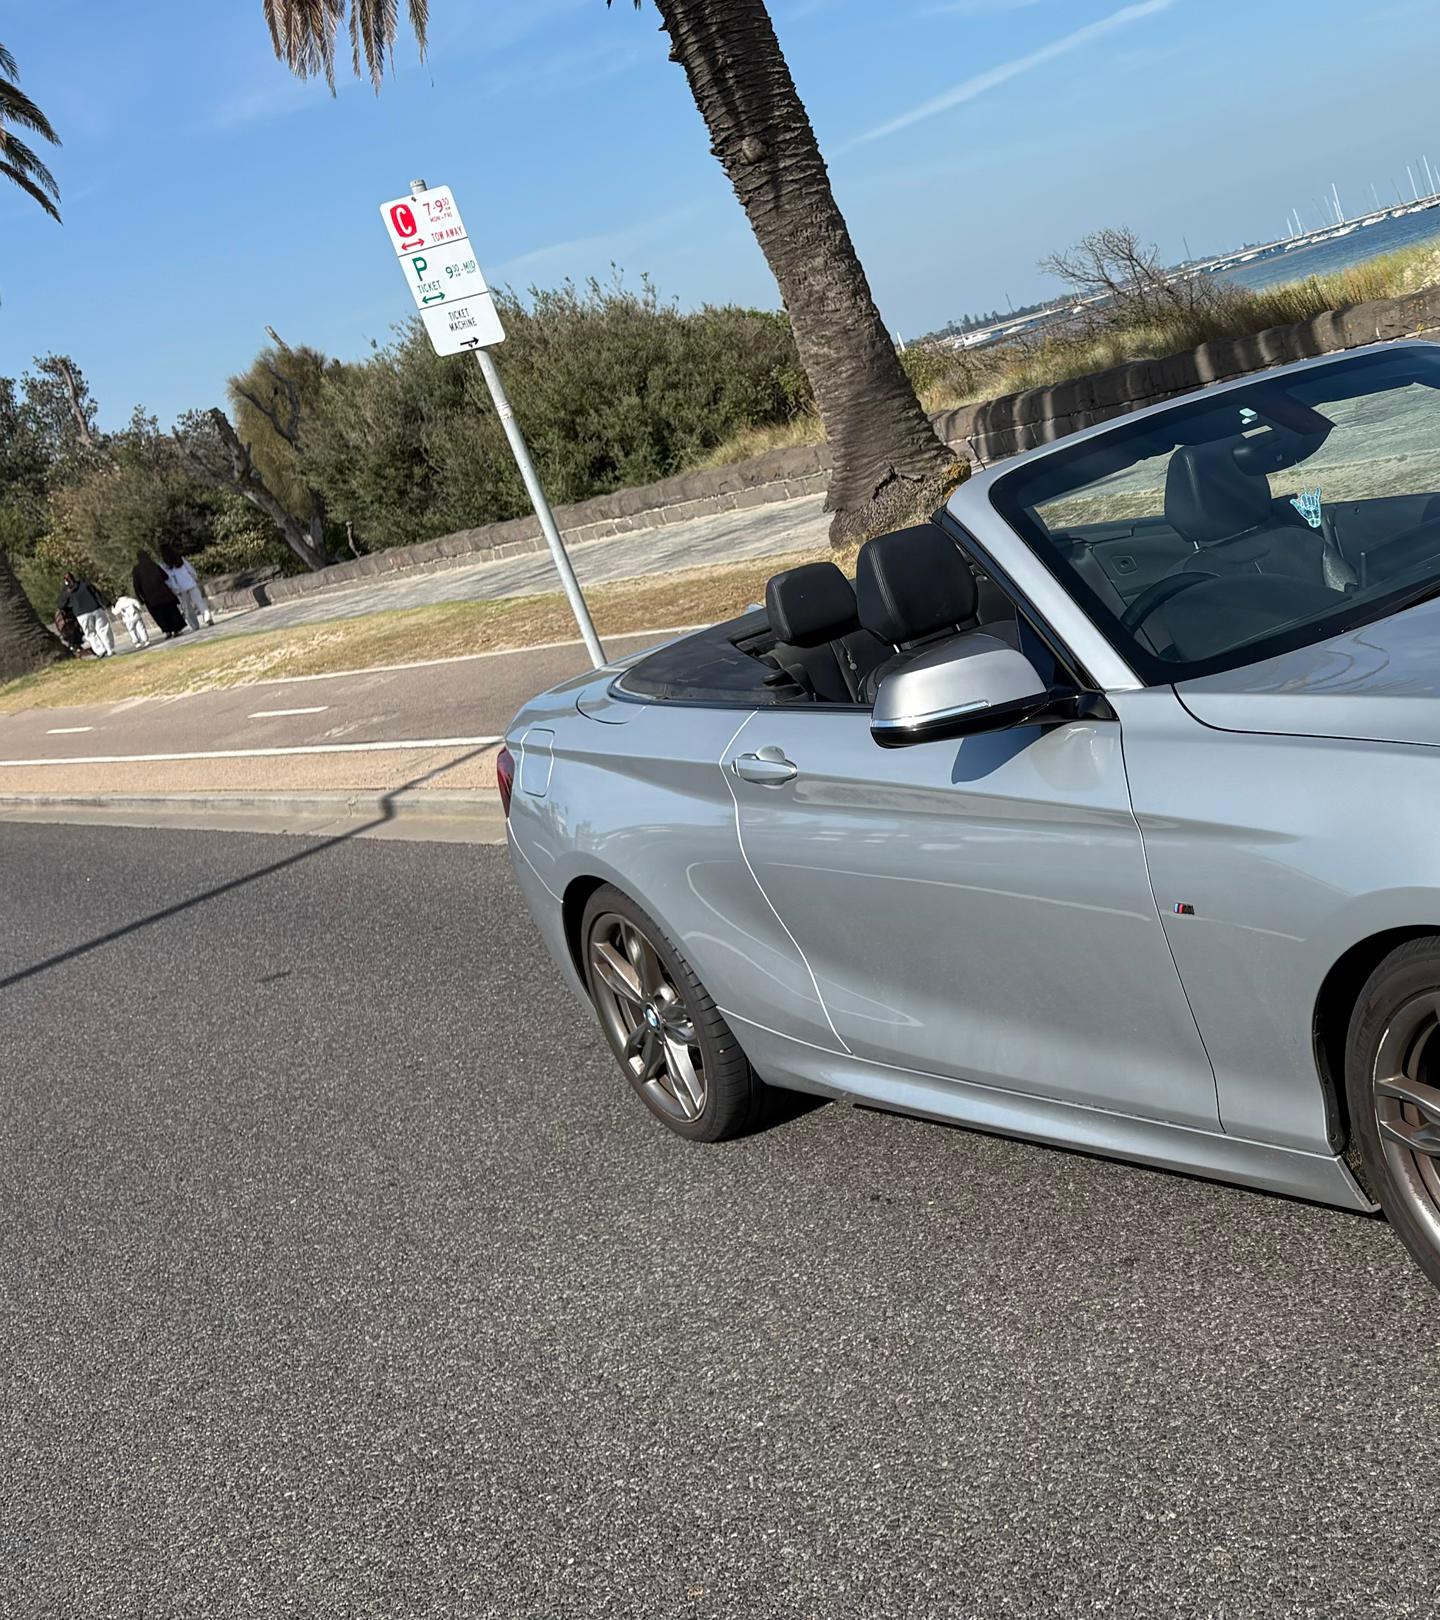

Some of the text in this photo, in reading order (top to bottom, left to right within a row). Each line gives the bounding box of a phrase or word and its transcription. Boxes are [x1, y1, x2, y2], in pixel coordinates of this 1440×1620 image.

[395, 206, 413, 235] C
[431, 225, 463, 242] TOW AWAY
[412, 256, 428, 282] P
[416, 280, 442, 294] TICKET
[448, 307, 470, 320] TICKET
[448, 317, 478, 332] MACHINE
